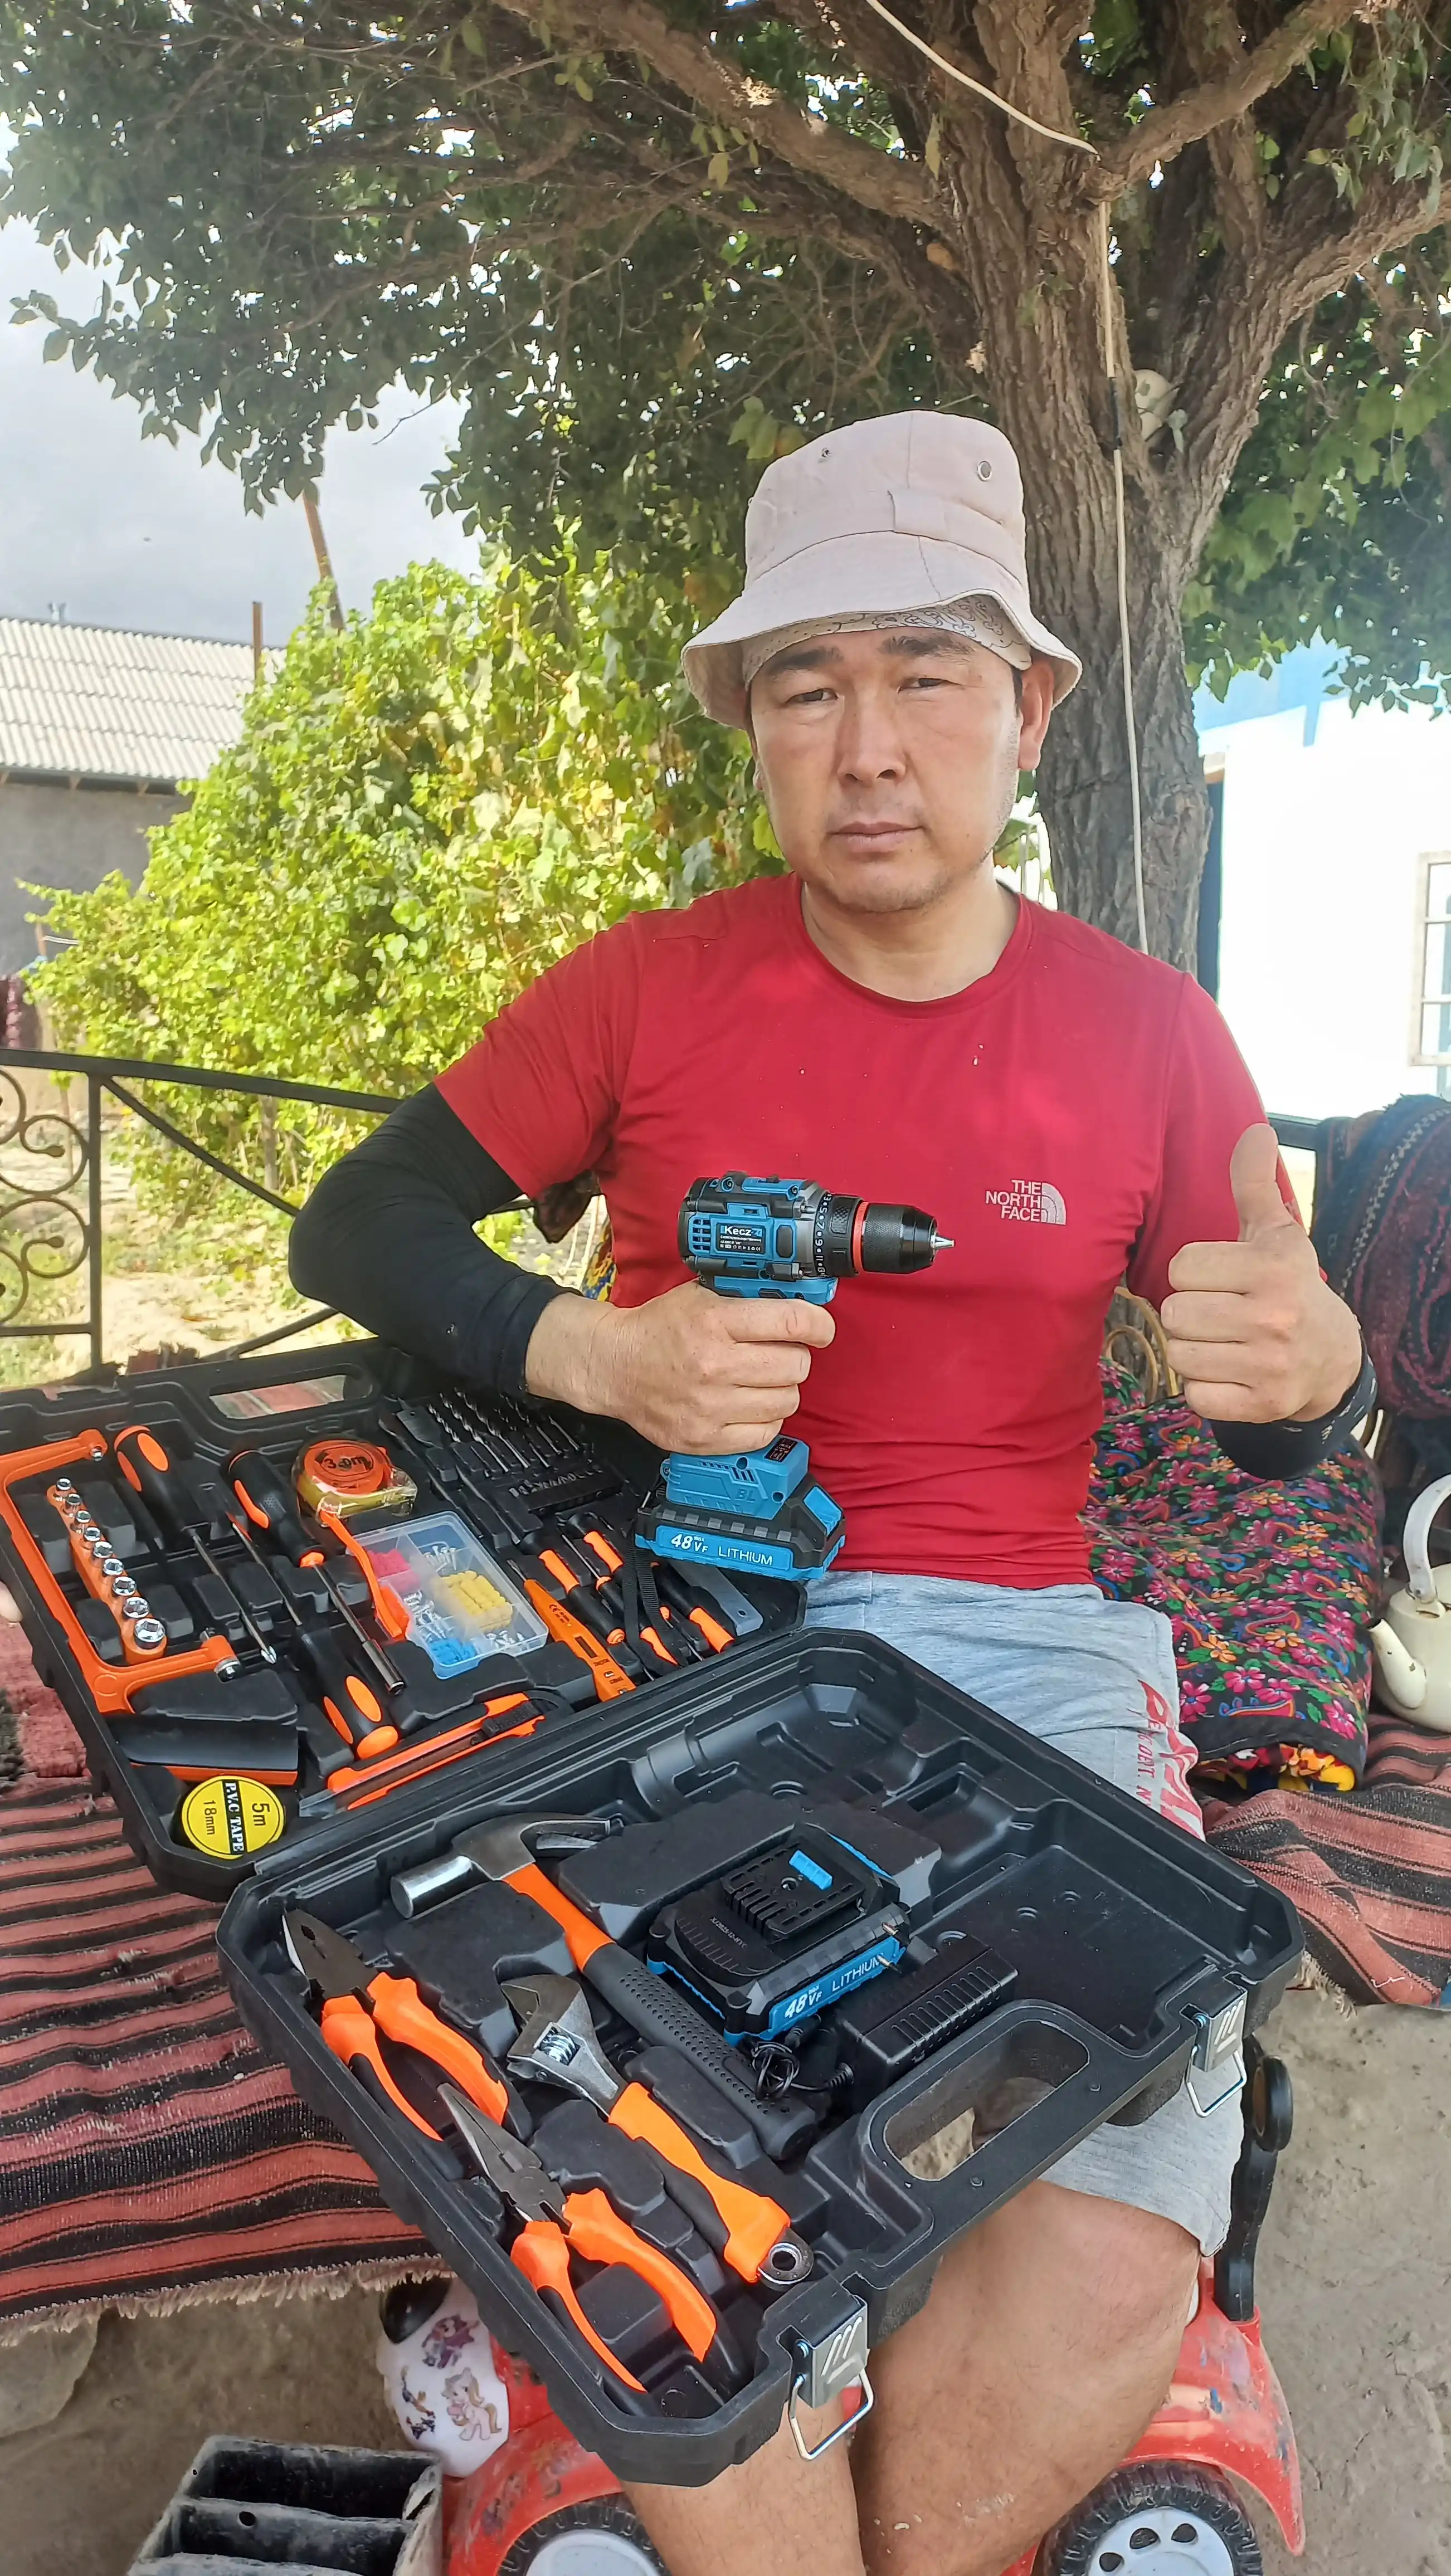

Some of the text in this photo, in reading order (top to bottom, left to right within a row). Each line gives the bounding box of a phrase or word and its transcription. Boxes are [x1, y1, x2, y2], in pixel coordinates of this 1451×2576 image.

[1011, 1179, 1041, 1196] THE
[985, 1191, 1041, 1208] NORTH
[1001, 1205, 1040, 1222] FACE
[816, 1222, 825, 1230] 7
[718, 1546, 773, 1565] LITHIUM
[203, 1799, 217, 1835] 18mm
[225, 1782, 245, 1852] P.V.C TAPE
[251, 1803, 271, 1827] 5m
